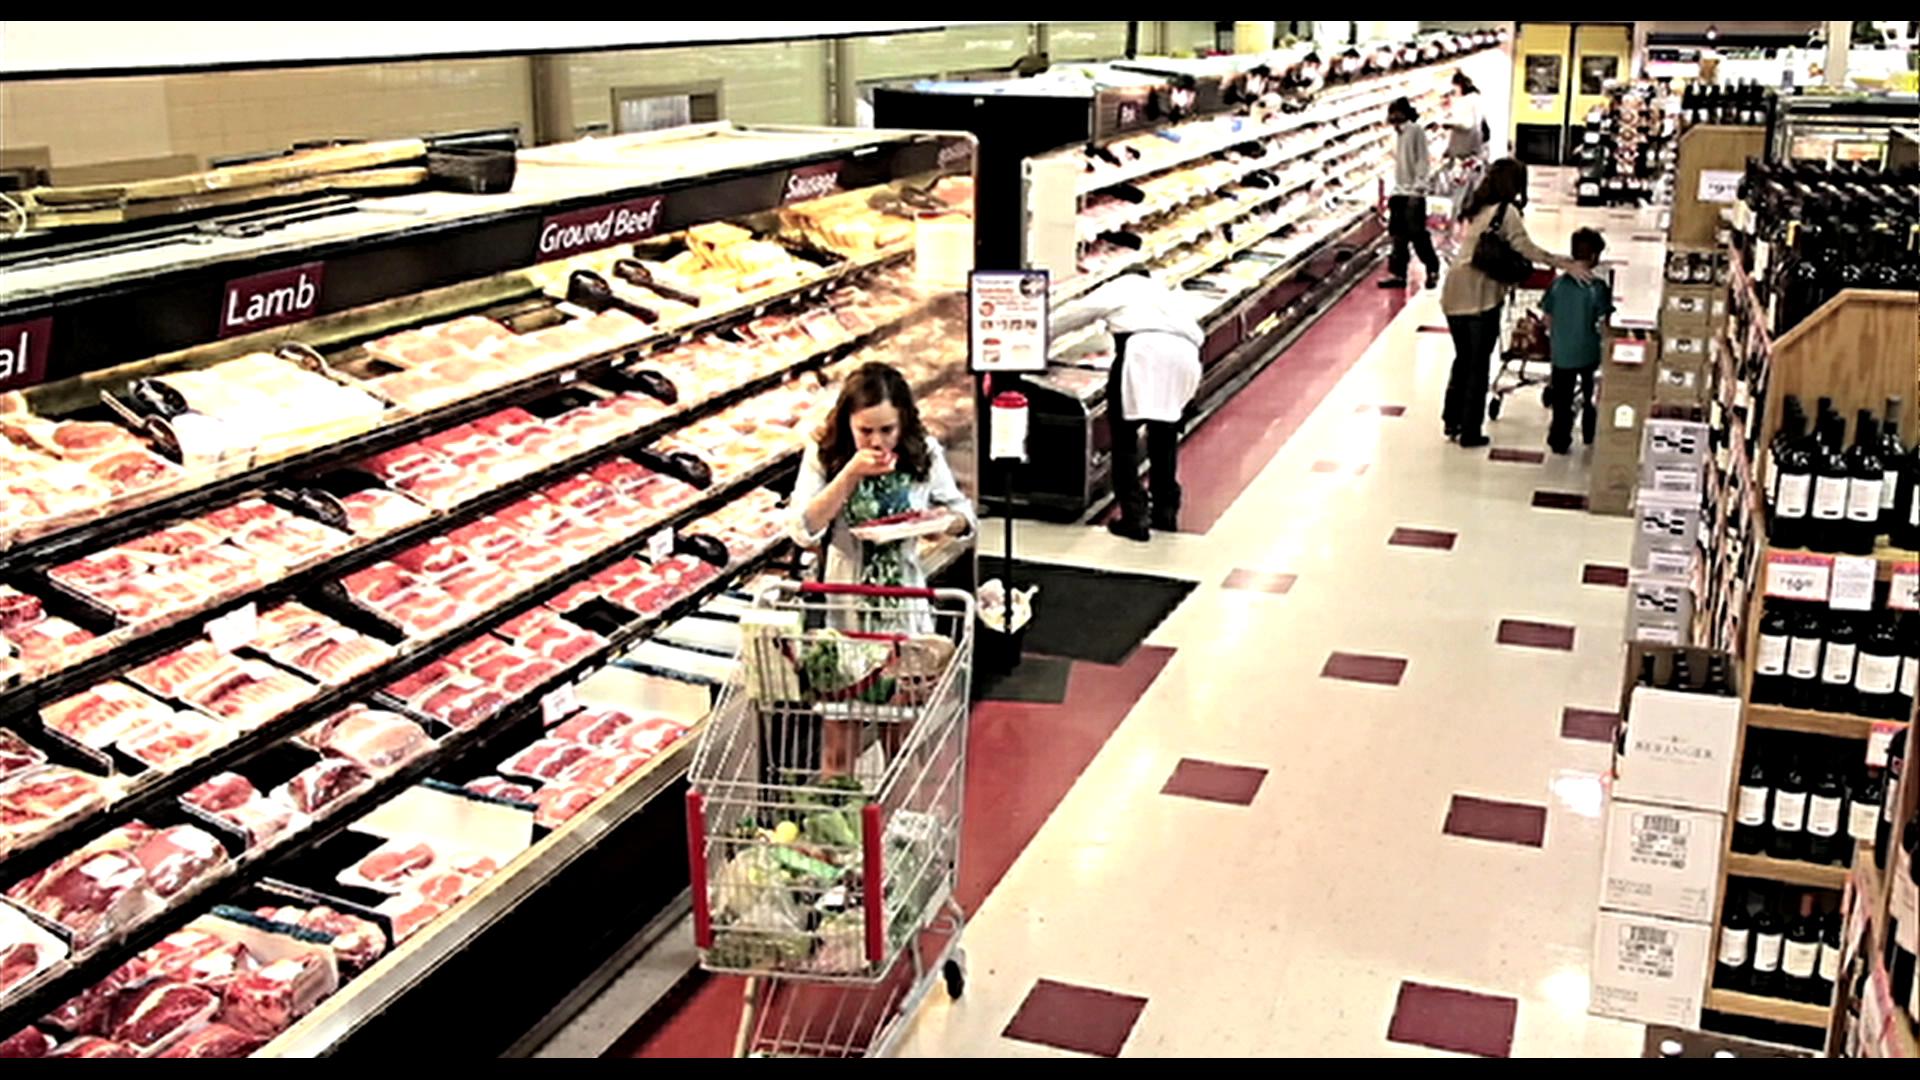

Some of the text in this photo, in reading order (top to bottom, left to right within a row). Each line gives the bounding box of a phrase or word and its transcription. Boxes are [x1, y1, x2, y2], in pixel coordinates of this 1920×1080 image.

[785, 172, 838, 199] Sausage
[539, 199, 661, 253] Ground Beef
[225, 273, 315, 326] Lamb
